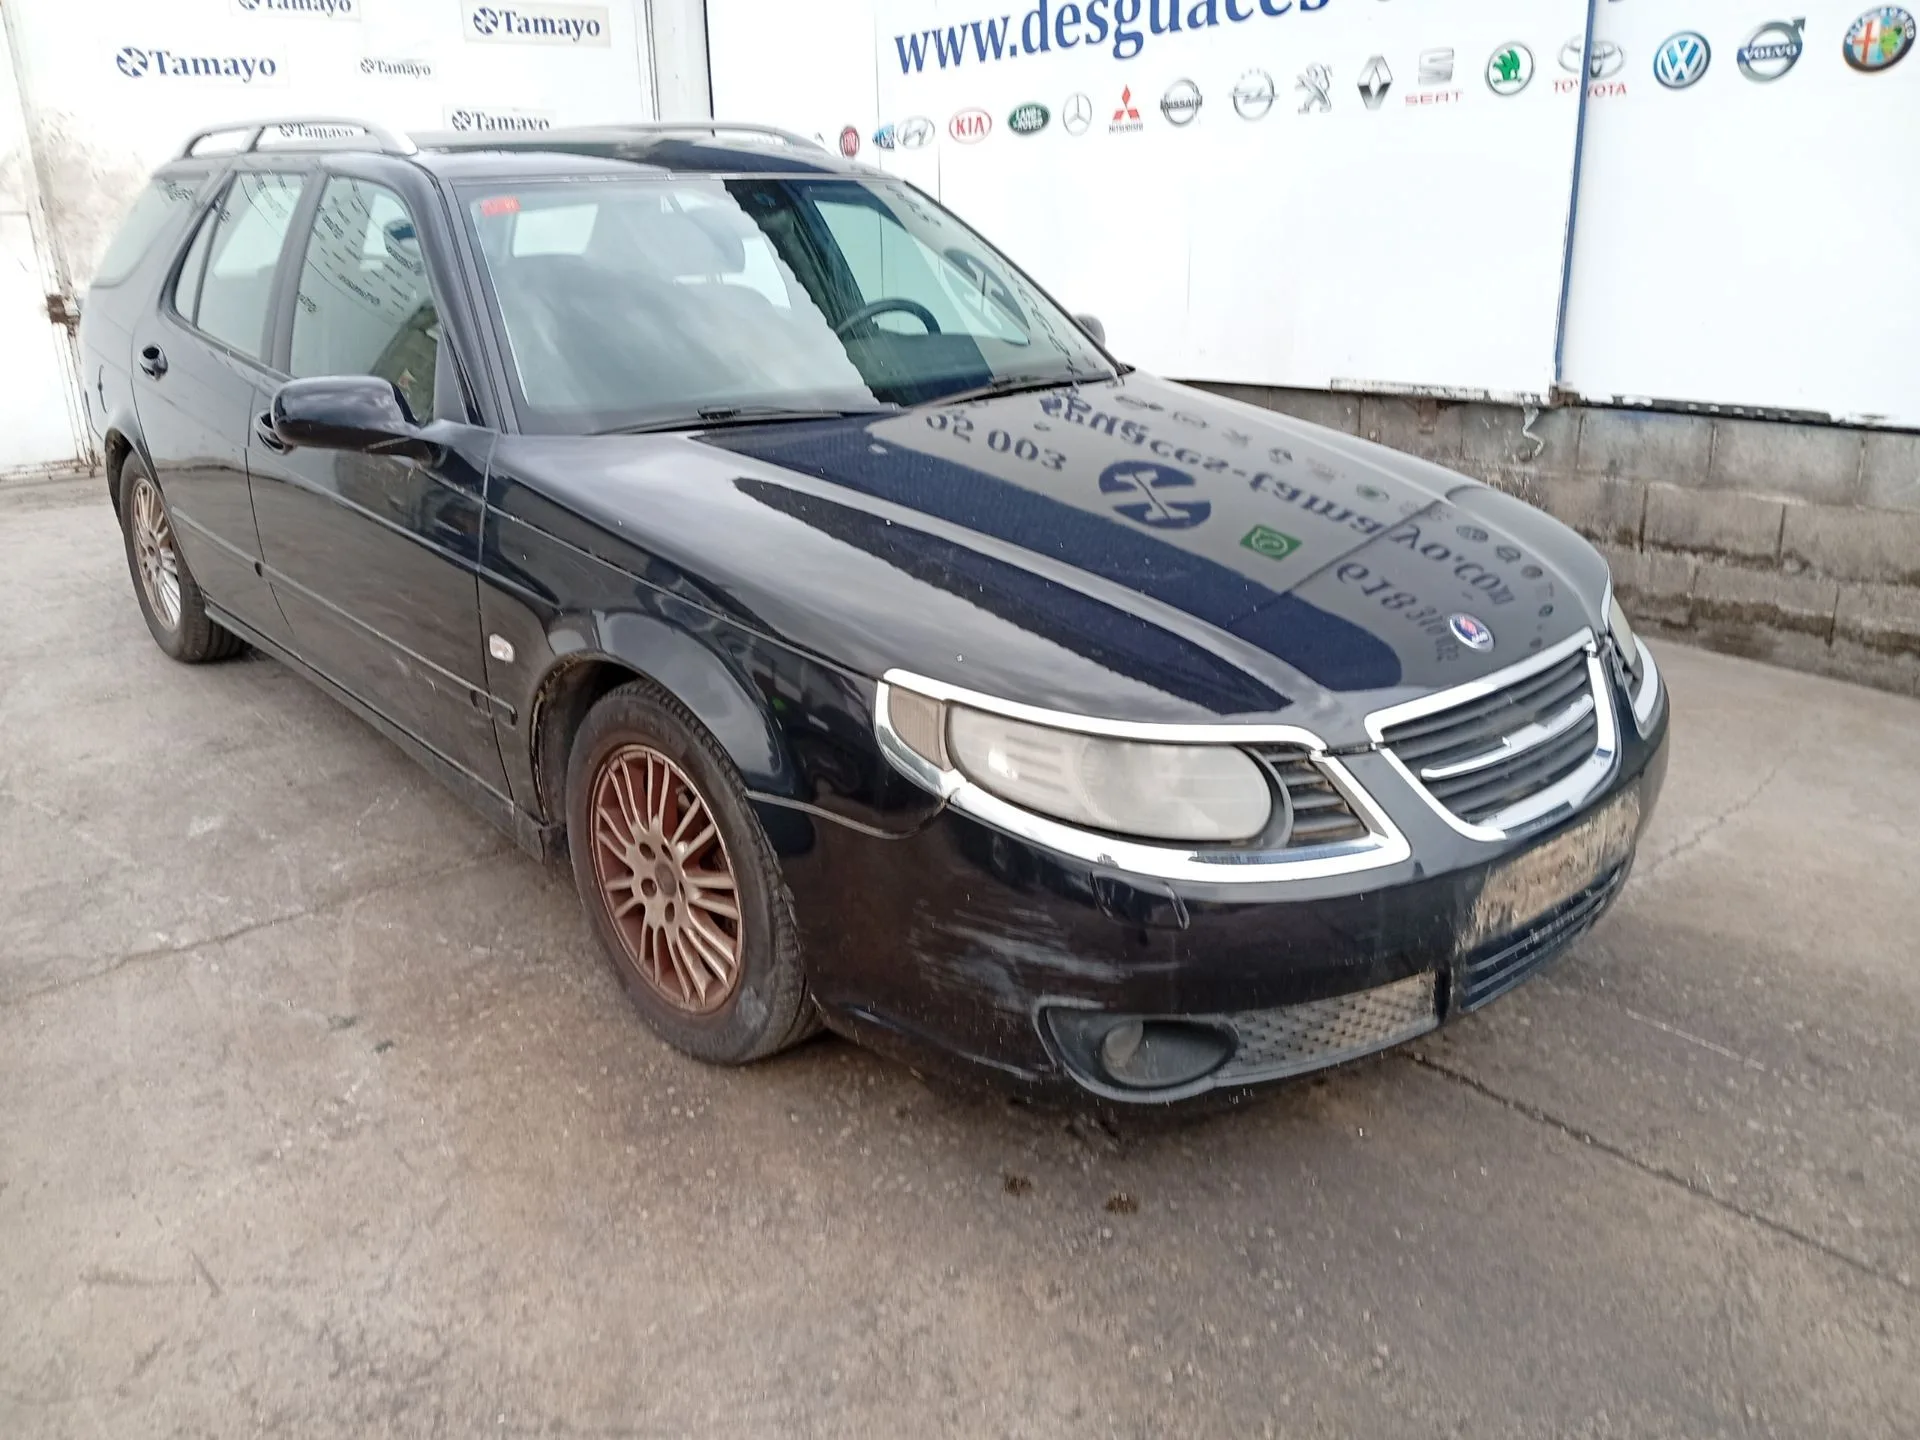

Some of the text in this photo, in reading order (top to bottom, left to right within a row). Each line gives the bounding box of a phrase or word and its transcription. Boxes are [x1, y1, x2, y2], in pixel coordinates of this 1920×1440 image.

[499, 10, 601, 42] Tamayo
[894, 0, 1329, 74] www.desgua
[1743, 44, 1798, 61] VOLVO
[149, 49, 277, 83] Tamayo
[375, 58, 431, 79] Tamayo
[1161, 98, 1202, 111] NISSAN
[1405, 90, 1464, 104] SEAT
[956, 115, 985, 137] KIA
